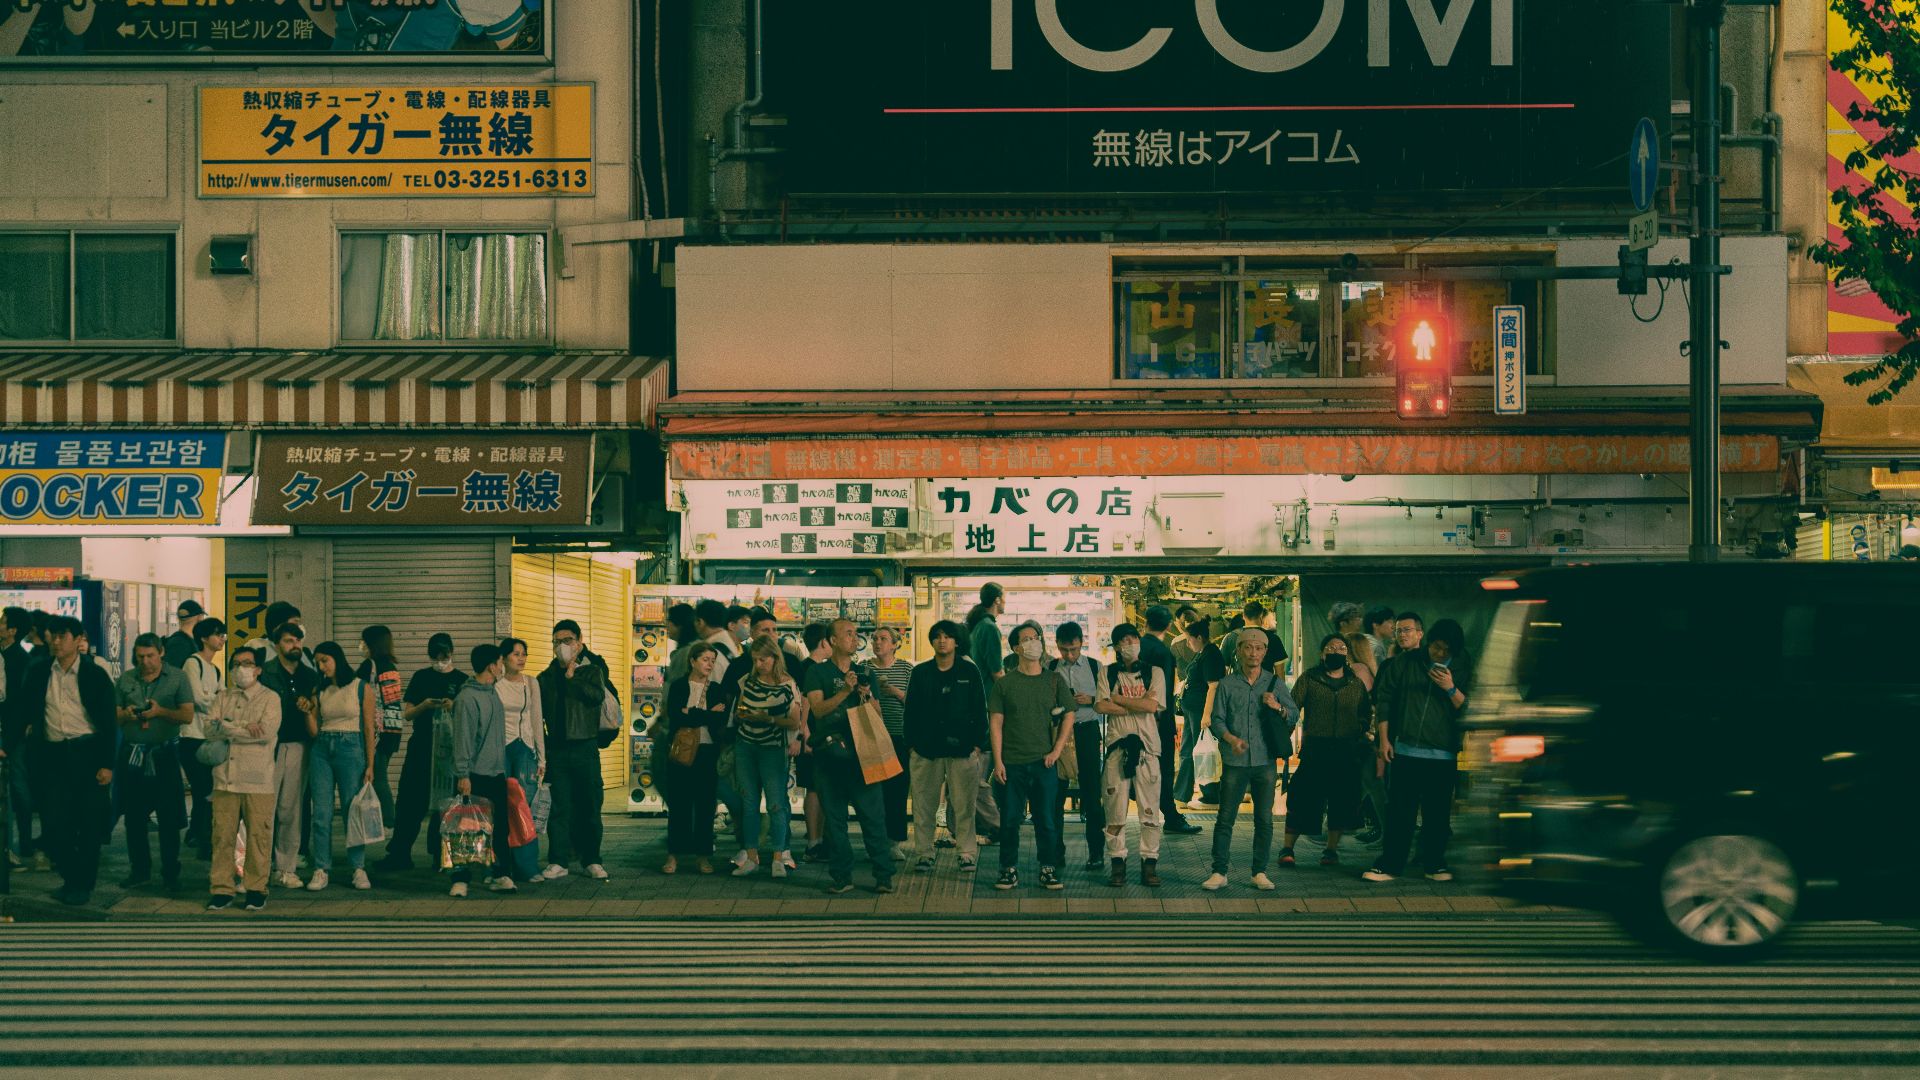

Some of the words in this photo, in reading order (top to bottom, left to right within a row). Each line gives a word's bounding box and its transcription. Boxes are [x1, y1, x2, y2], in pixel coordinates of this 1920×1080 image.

[138, 20, 198, 40] 入り口
[210, 19, 314, 40] 当ビル2階
[260, 111, 534, 156] タイガー無線
[1091, 128, 1361, 168] 無線はアイコム
[208, 172, 393, 189] http://www.tigermusen.com/
[1632, 219, 1654, 244] 8-20
[56, 440, 207, 466] 물품보관함
[0, 473, 204, 519] OCKER
[281, 469, 563, 513] タイガー無線
[937, 486, 1133, 517] カベの店
[964, 523, 1100, 553] 地上店
